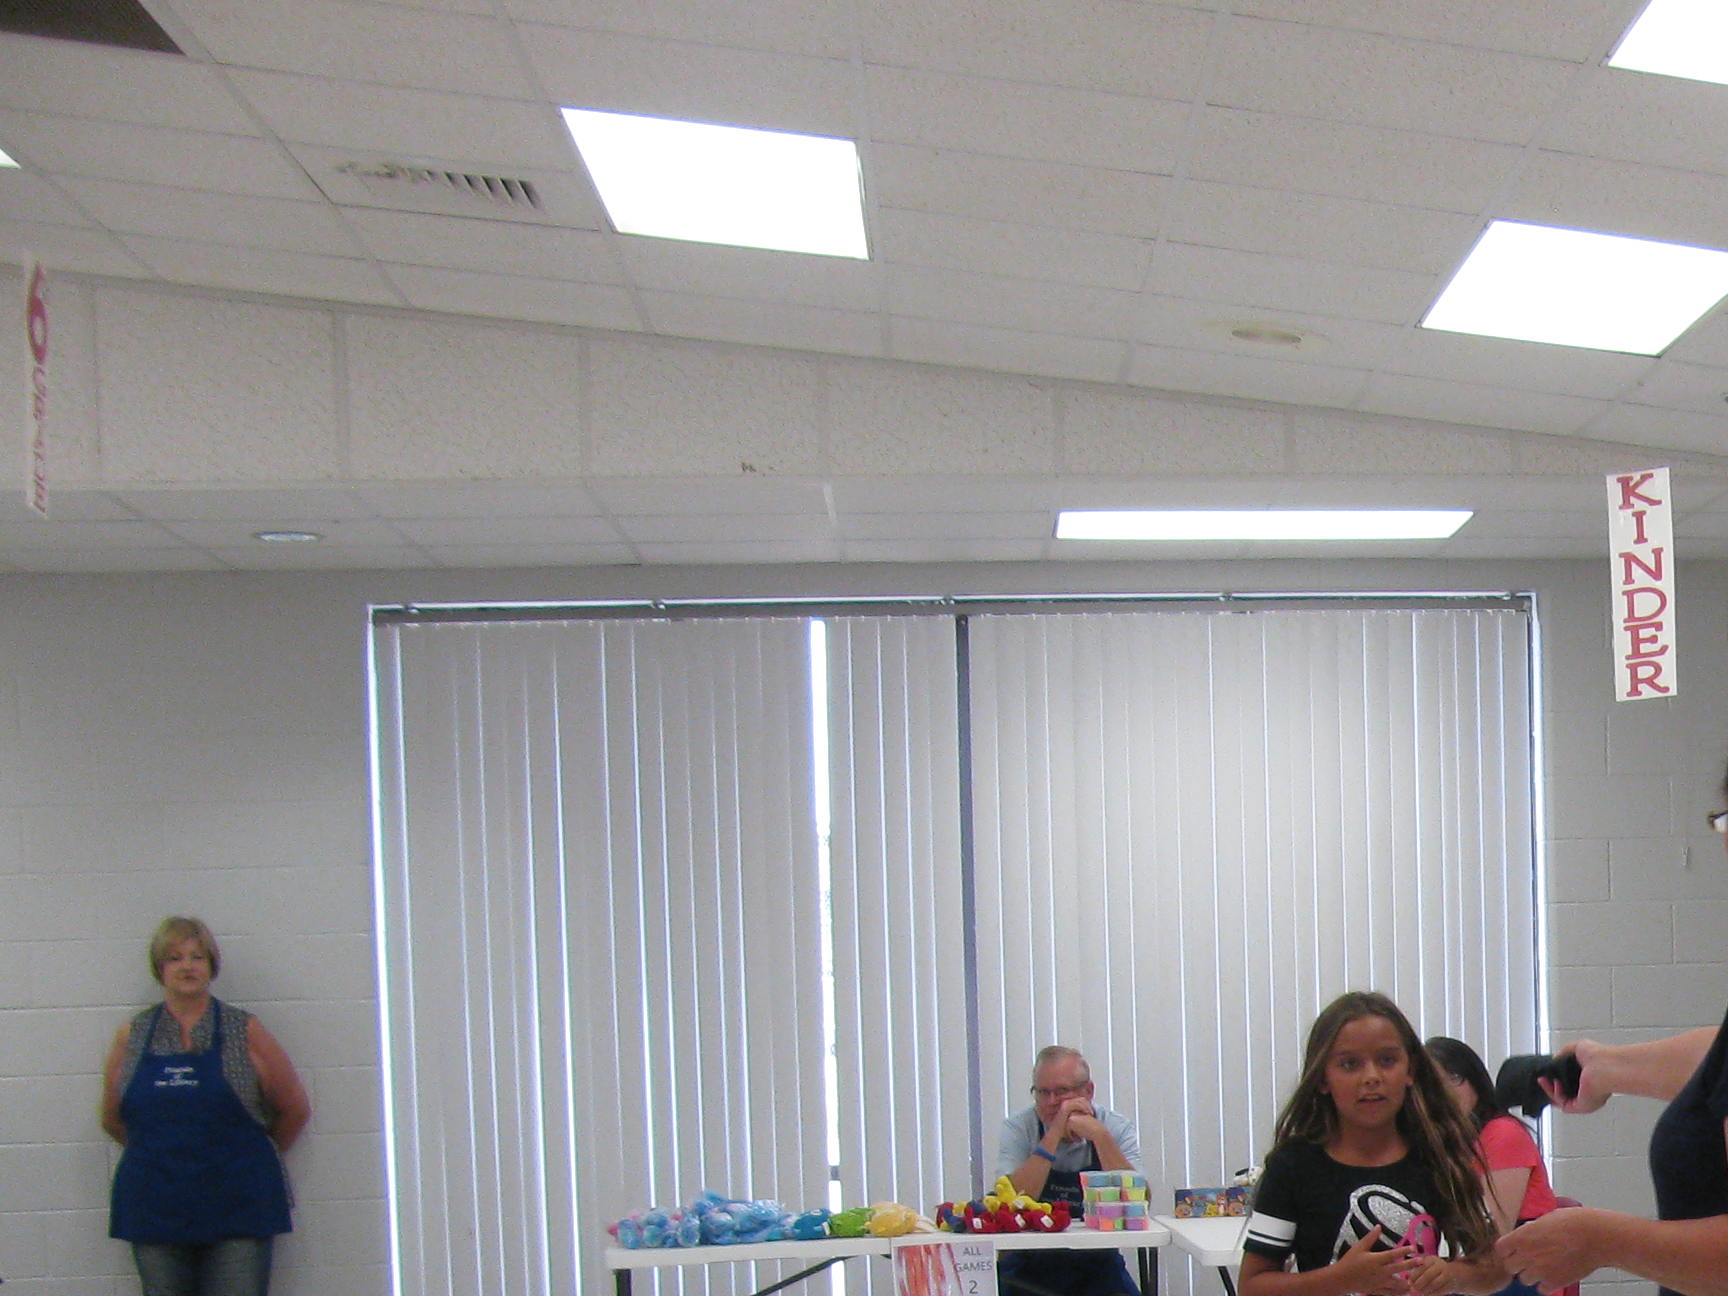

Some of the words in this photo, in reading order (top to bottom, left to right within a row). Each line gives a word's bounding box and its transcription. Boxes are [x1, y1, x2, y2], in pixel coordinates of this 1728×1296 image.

[1615, 472, 1670, 698] KINDER
[962, 1247, 983, 1256] ALL
[956, 1262, 993, 1273] GAMES
[968, 1279, 979, 1295] 2
